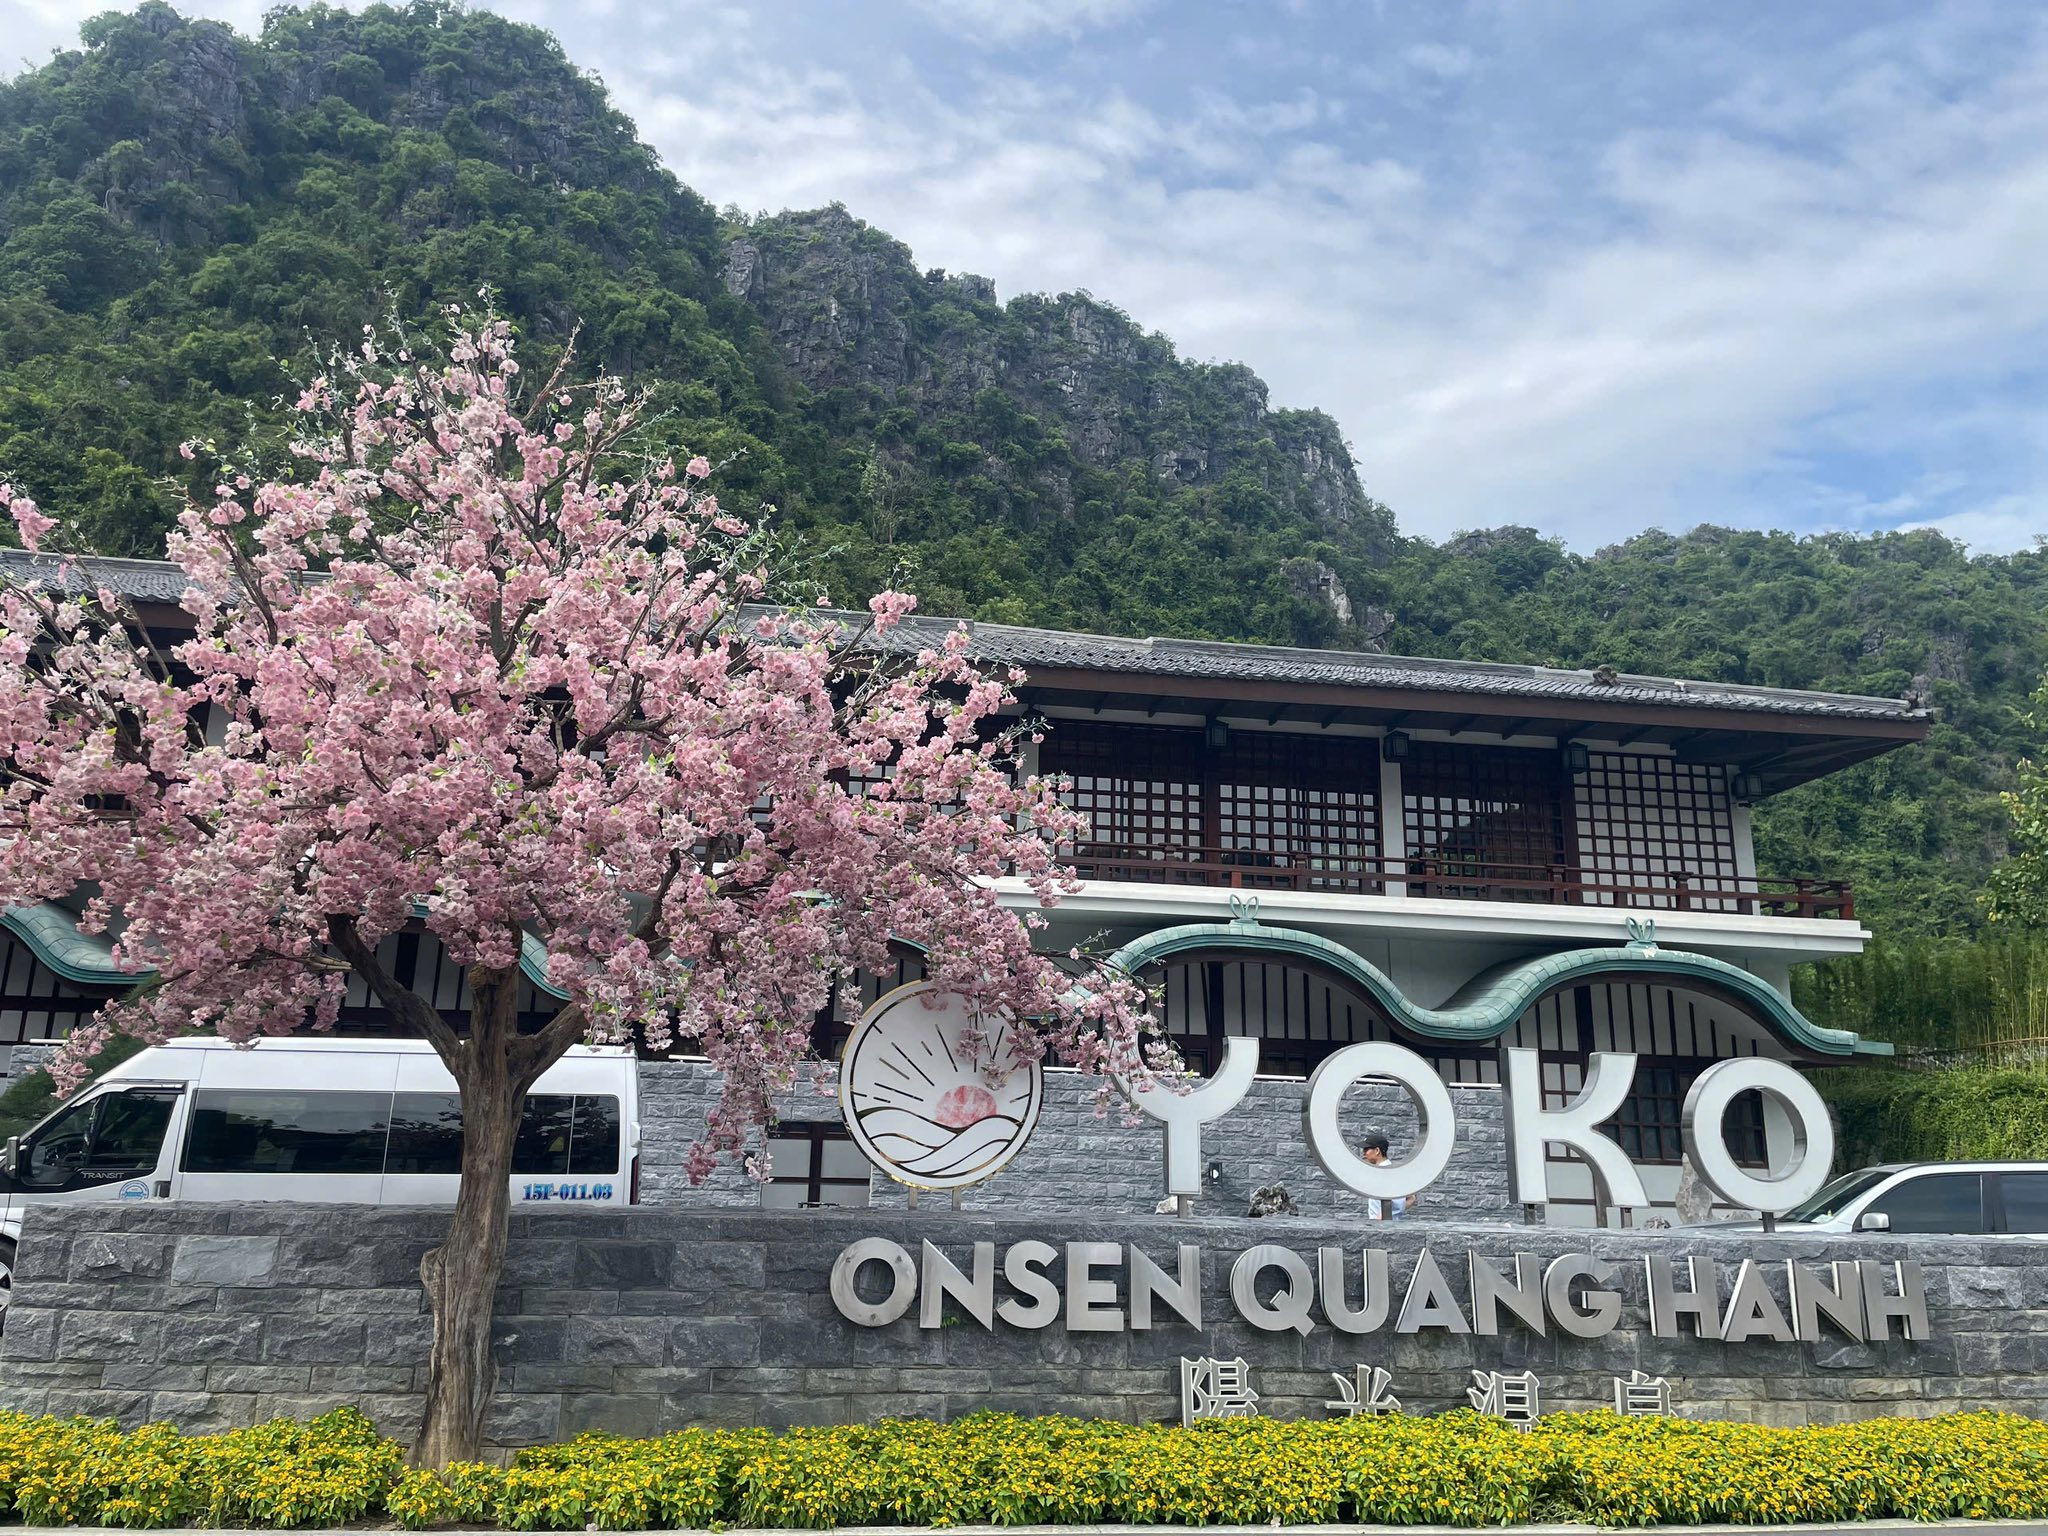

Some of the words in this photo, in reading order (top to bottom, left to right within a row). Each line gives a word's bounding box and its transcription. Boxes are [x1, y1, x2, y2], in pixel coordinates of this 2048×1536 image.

[81, 1171, 125, 1179] TRANSIT
[1106, 1037, 1835, 1211] YOKO
[830, 1237, 1202, 1332] ONSEN
[1230, 1245, 1622, 1338] QUANG
[1645, 1254, 1930, 1343] HANH
